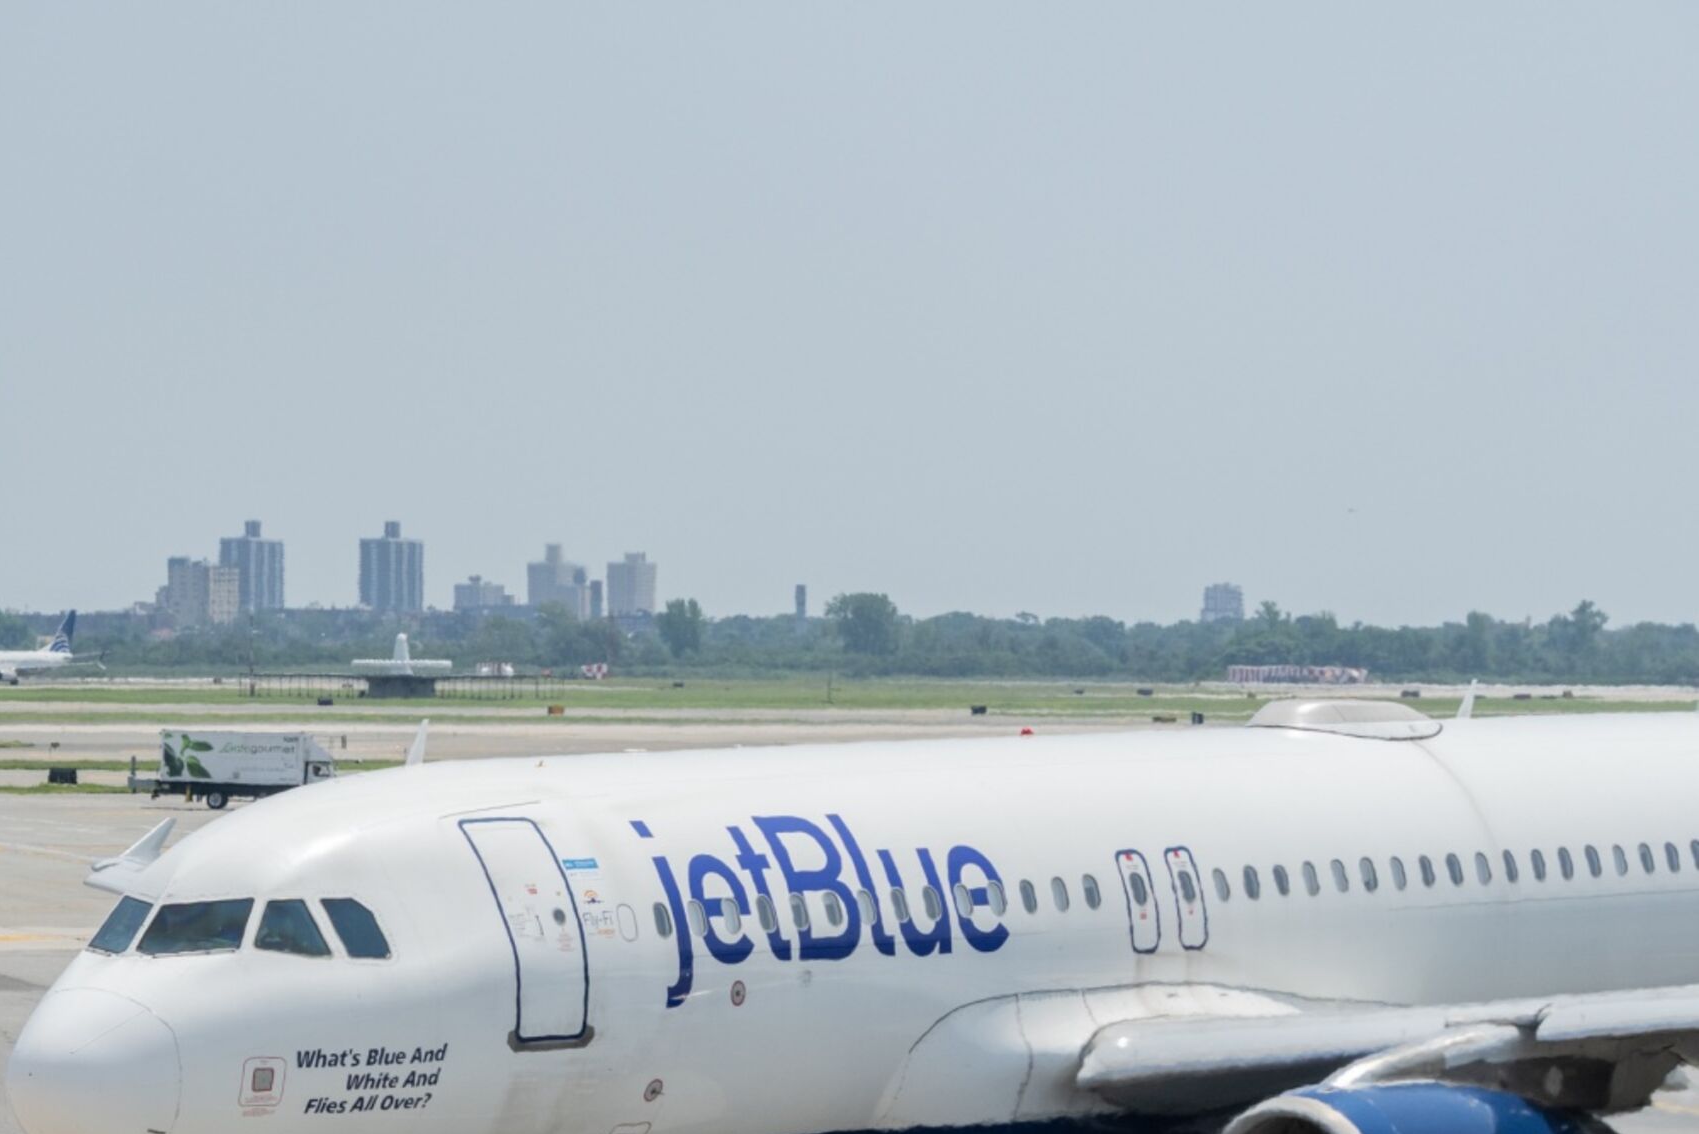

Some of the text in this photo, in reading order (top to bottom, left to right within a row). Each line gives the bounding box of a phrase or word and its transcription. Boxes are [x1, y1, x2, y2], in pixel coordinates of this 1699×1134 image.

[629, 813, 1010, 1009] jetBlue
[296, 1043, 448, 1068] What's Blue And
[346, 1068, 441, 1090] White And
[304, 1093, 432, 1114] Flies All Over?
